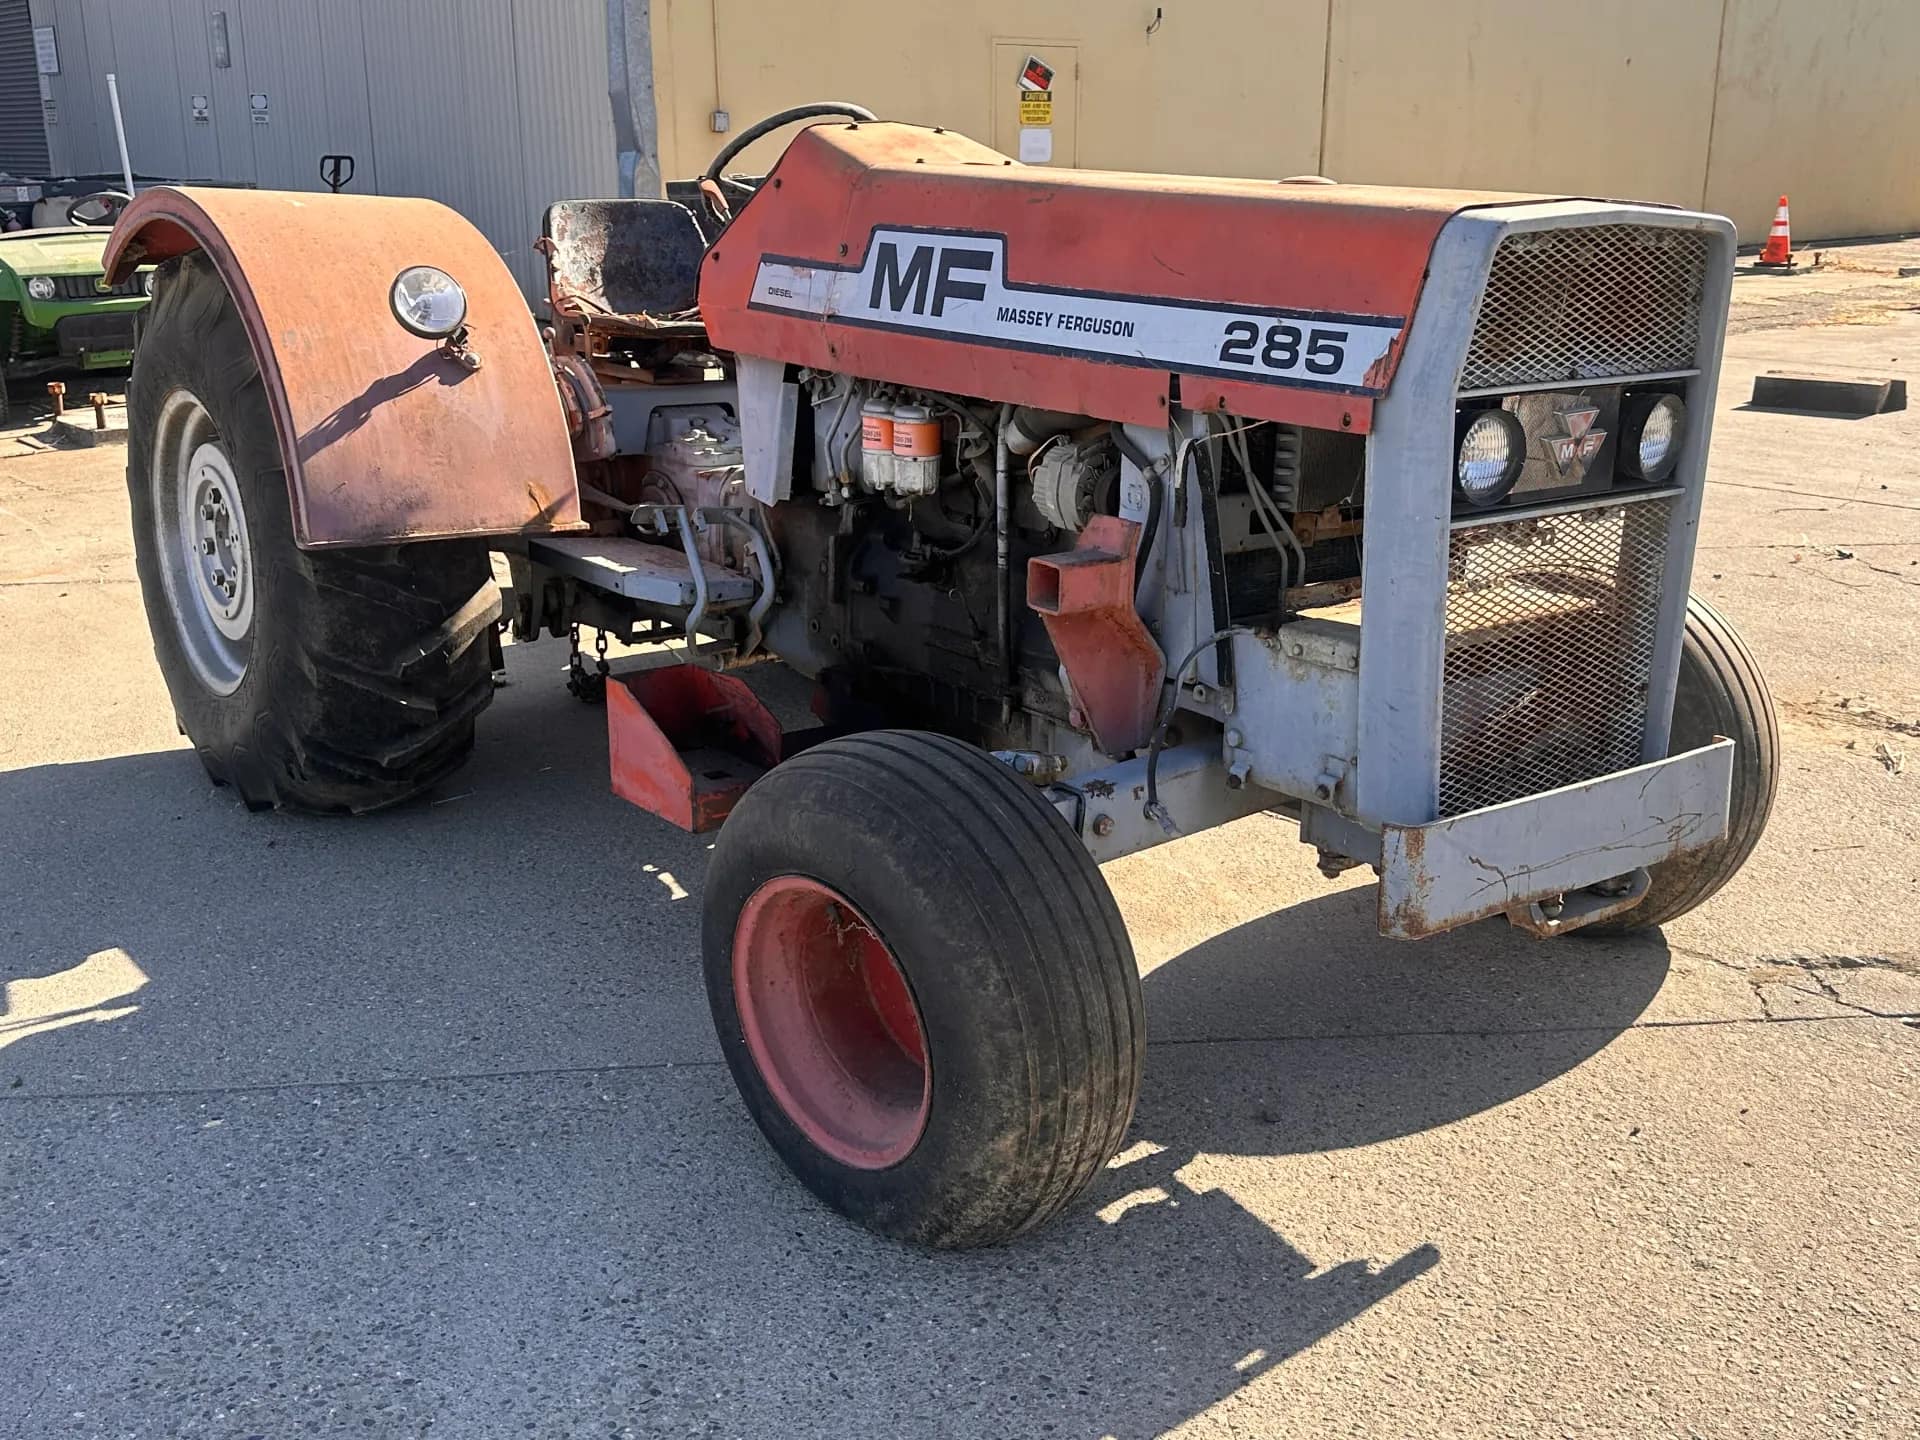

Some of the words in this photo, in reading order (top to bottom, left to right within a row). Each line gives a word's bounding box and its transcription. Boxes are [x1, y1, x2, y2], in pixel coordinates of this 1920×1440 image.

[768, 286, 793, 298] DIESEL
[869, 242, 994, 317] MF
[997, 307, 1053, 328] MASSEY
[1057, 314, 1135, 337] FERGUSON
[1219, 320, 1349, 375] 285
